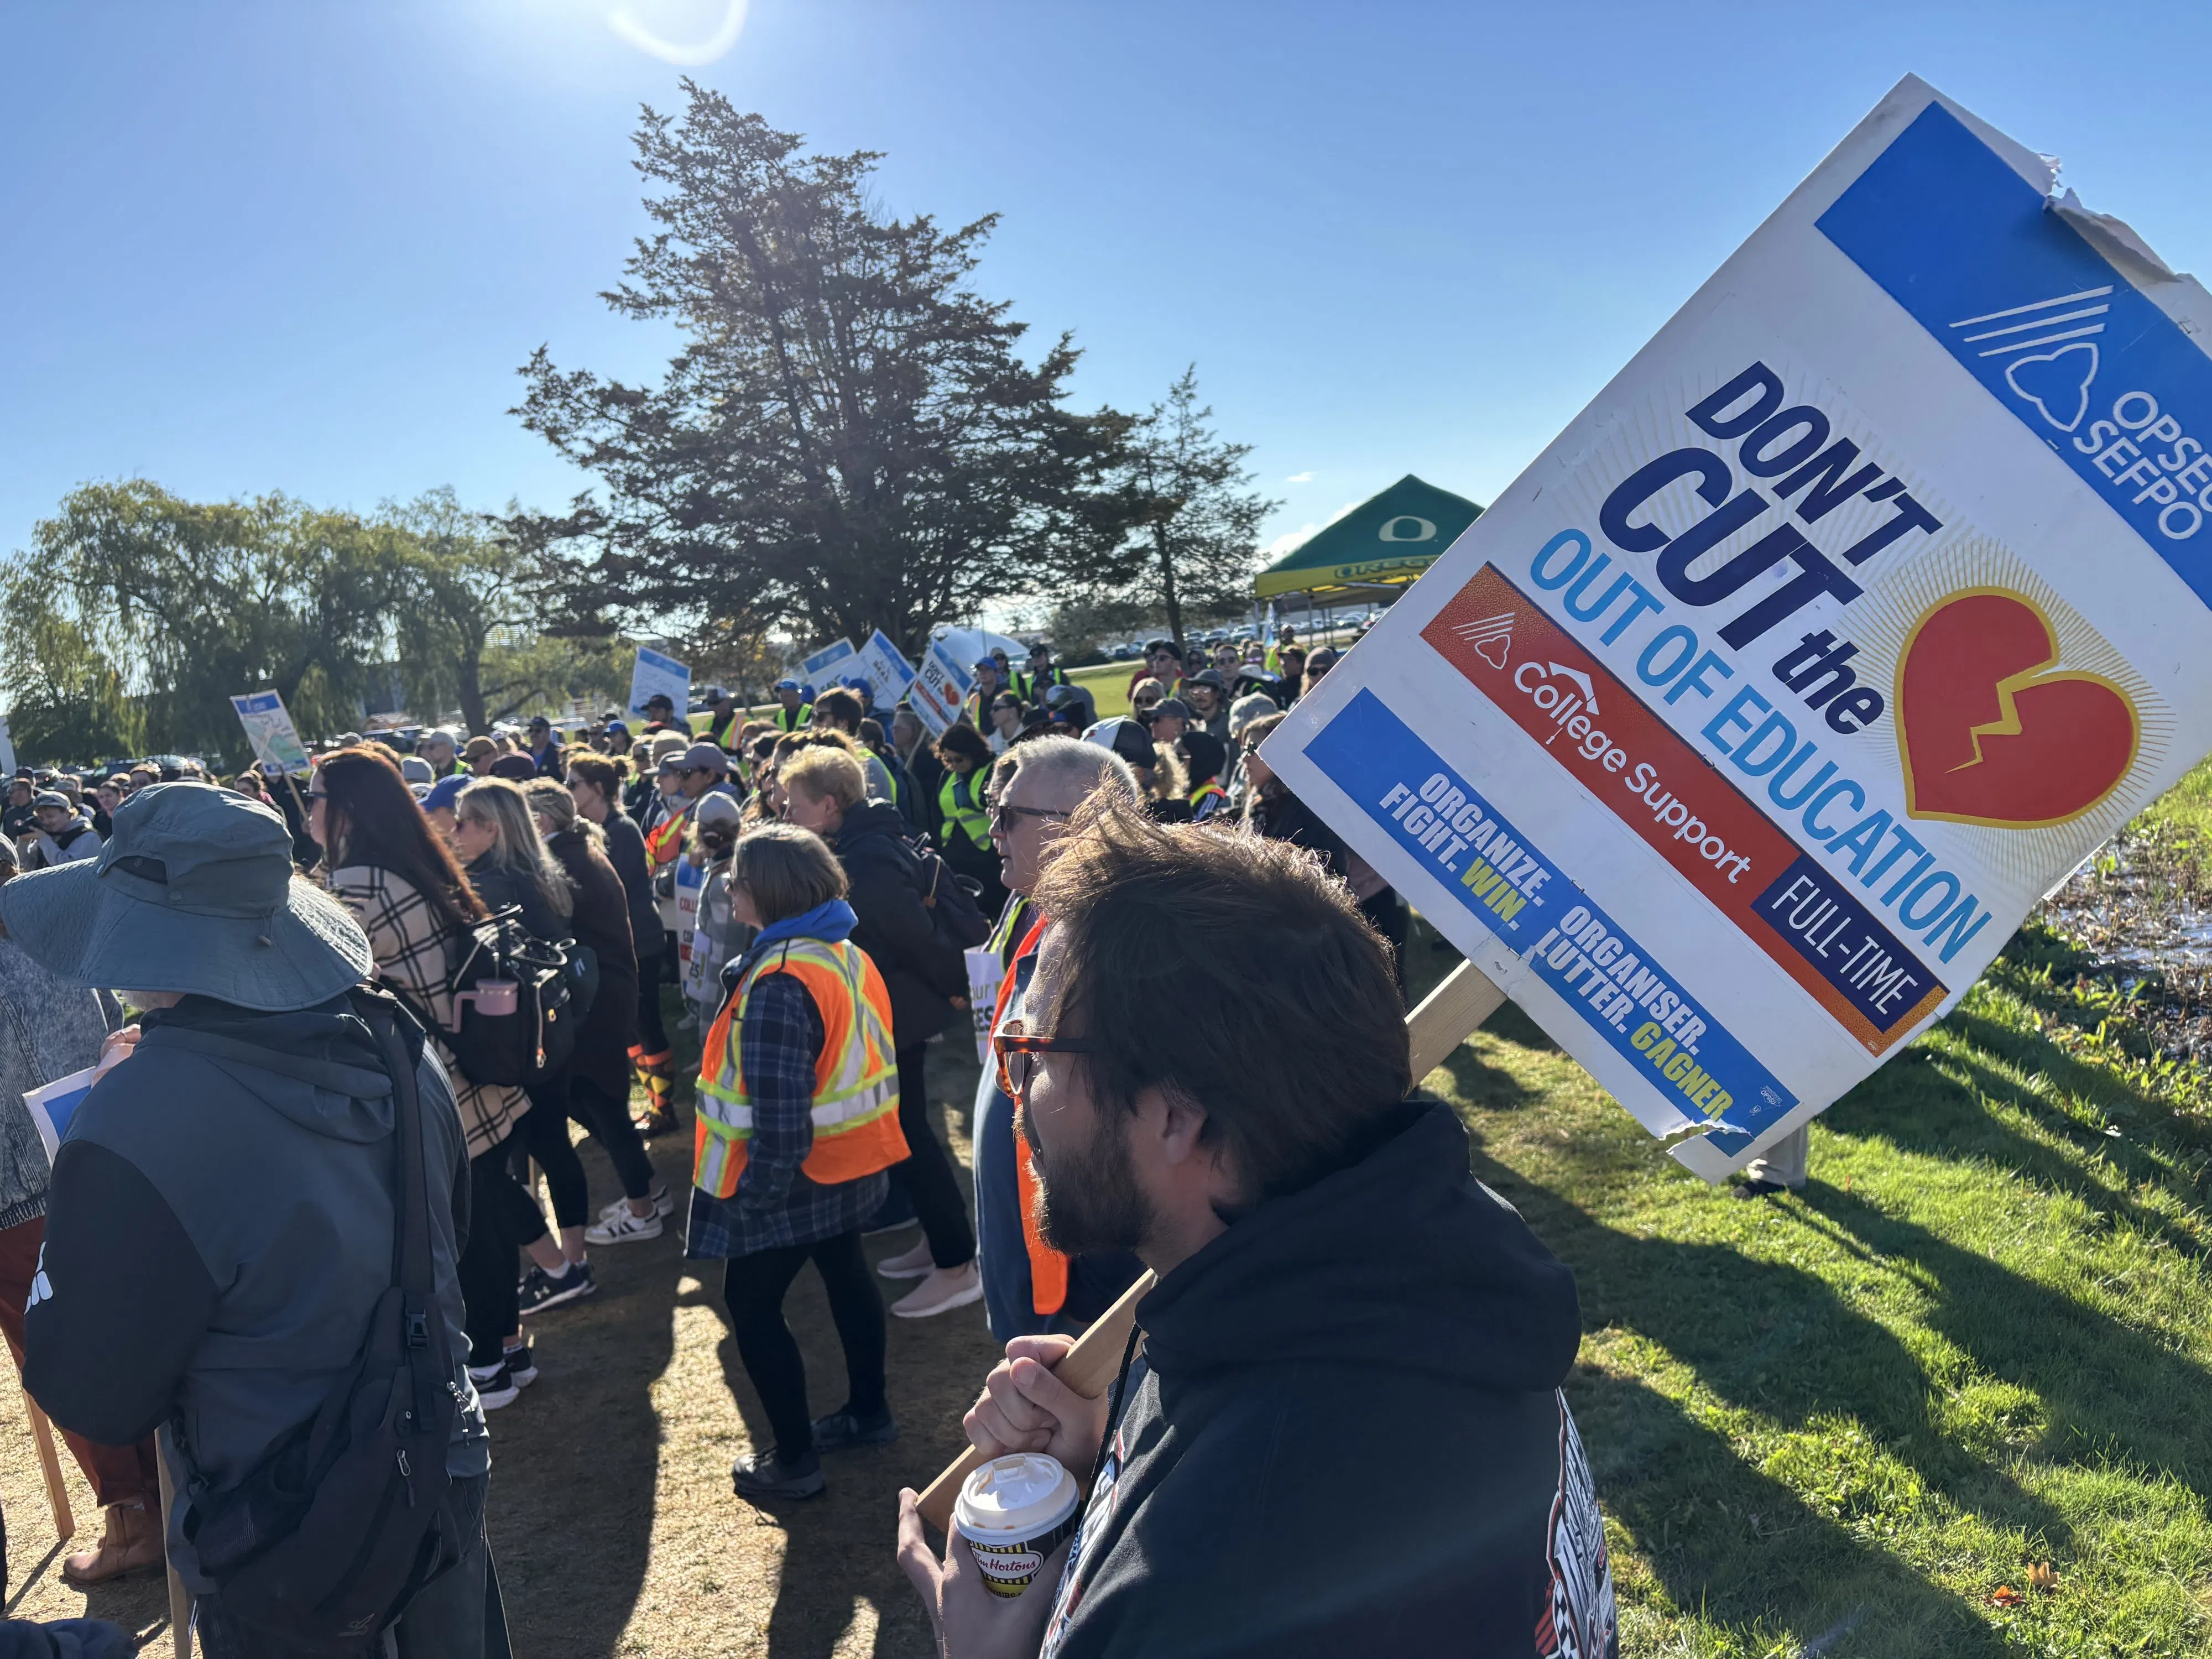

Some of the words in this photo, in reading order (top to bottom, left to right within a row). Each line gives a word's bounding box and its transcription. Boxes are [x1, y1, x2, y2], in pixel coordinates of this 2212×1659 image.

[1685, 361, 1944, 567] DON'T
[2073, 420, 2202, 540] SEFPO
[1599, 447, 1864, 651] CUT
[1530, 529, 1665, 647] OUT
[1636, 624, 1735, 706] OF
[1700, 684, 1992, 964] EDUCATION
[1772, 629, 1885, 734] the
[1419, 773, 1552, 907] ORGANIZE.
[1515, 661, 1627, 772] College
[1624, 763, 1751, 884] Support
[1379, 781, 1469, 872] FIGHT.
[1460, 856, 1527, 931] WIN.
[1559, 905, 1707, 1056] ORGANISER.
[1771, 874, 1918, 1015] FULL-TIME
[1535, 927, 1634, 1034] LUTTER.
[1630, 1021, 1734, 1121] GAGNER
[990, 1558, 1036, 1571] Hortons
